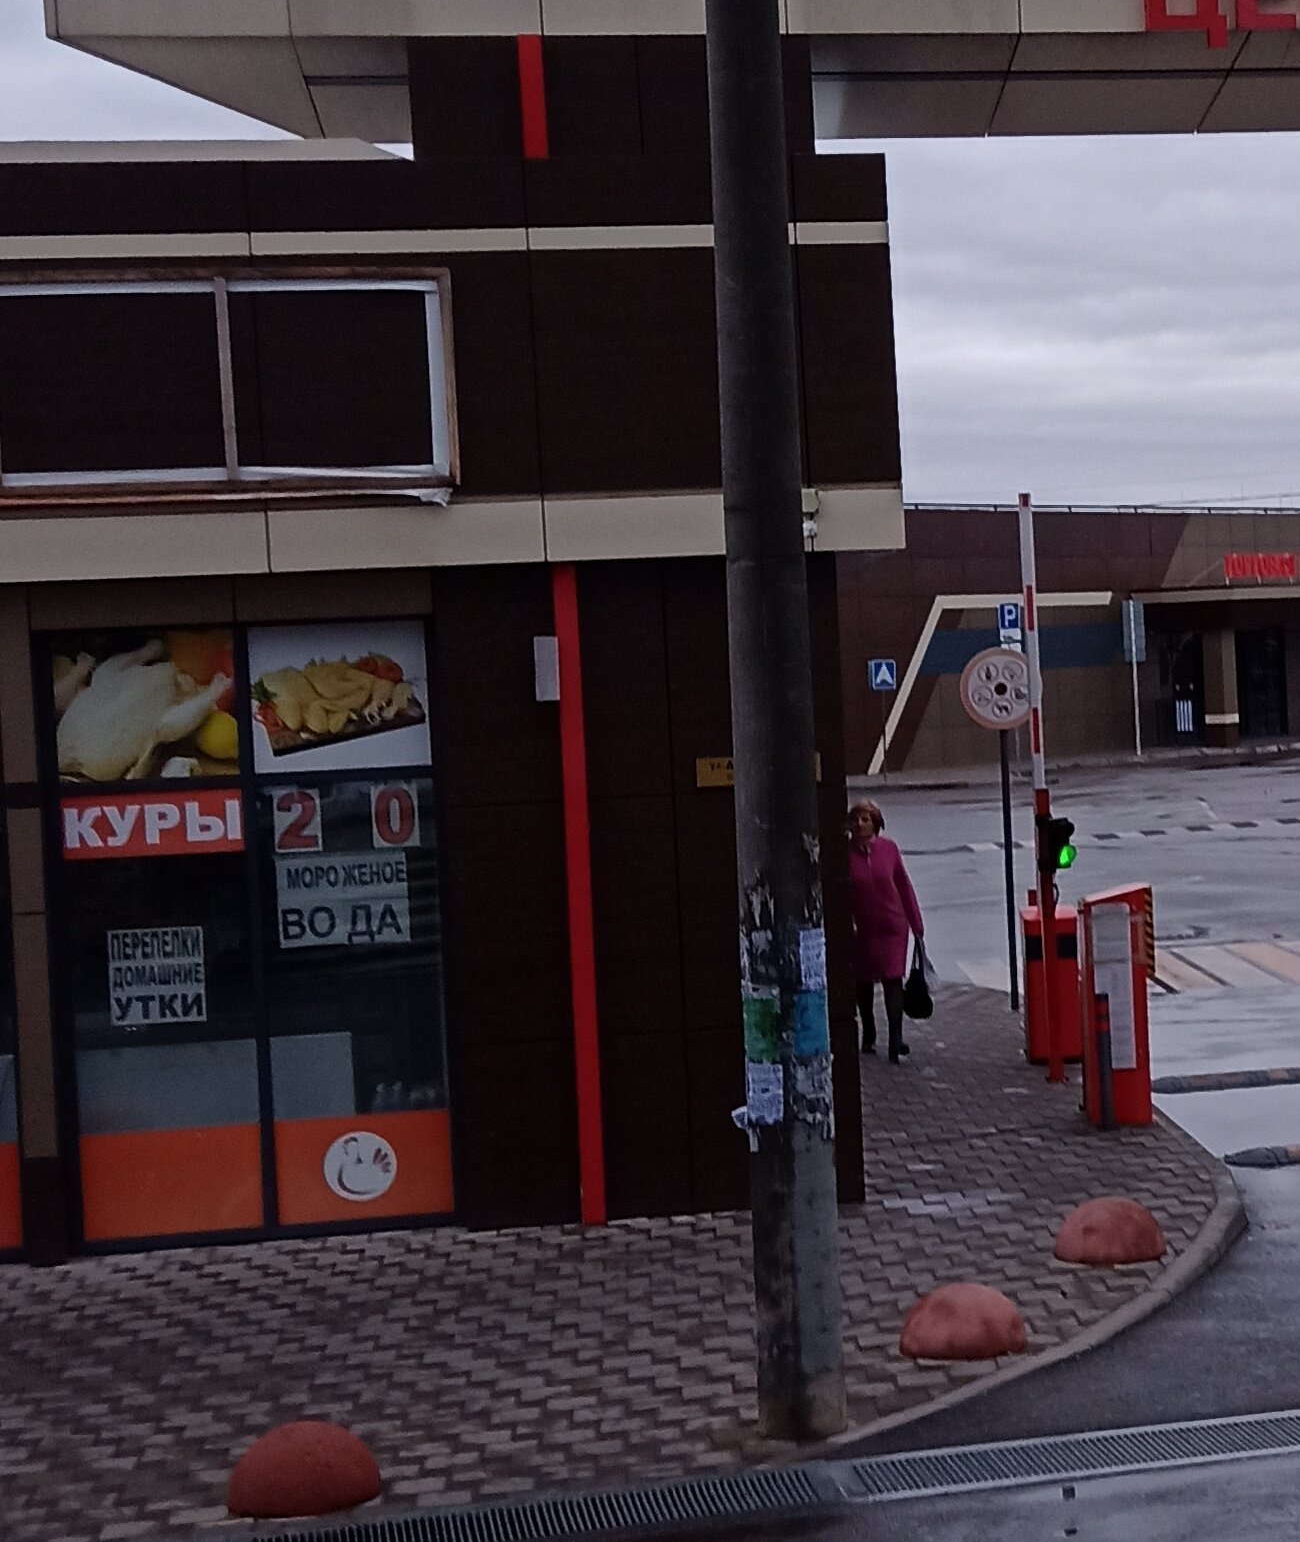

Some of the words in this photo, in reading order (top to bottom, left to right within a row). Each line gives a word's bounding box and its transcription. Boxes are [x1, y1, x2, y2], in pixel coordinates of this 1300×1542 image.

[1004, 605, 1016, 628] P
[63, 799, 242, 849] КУРЫ
[280, 903, 403, 945] ВОДА
[110, 929, 202, 960] ПЕРЕПЕЛКИ
[112, 962, 204, 990] ДОМАШНИЕ
[113, 990, 204, 1021] УТКИ
